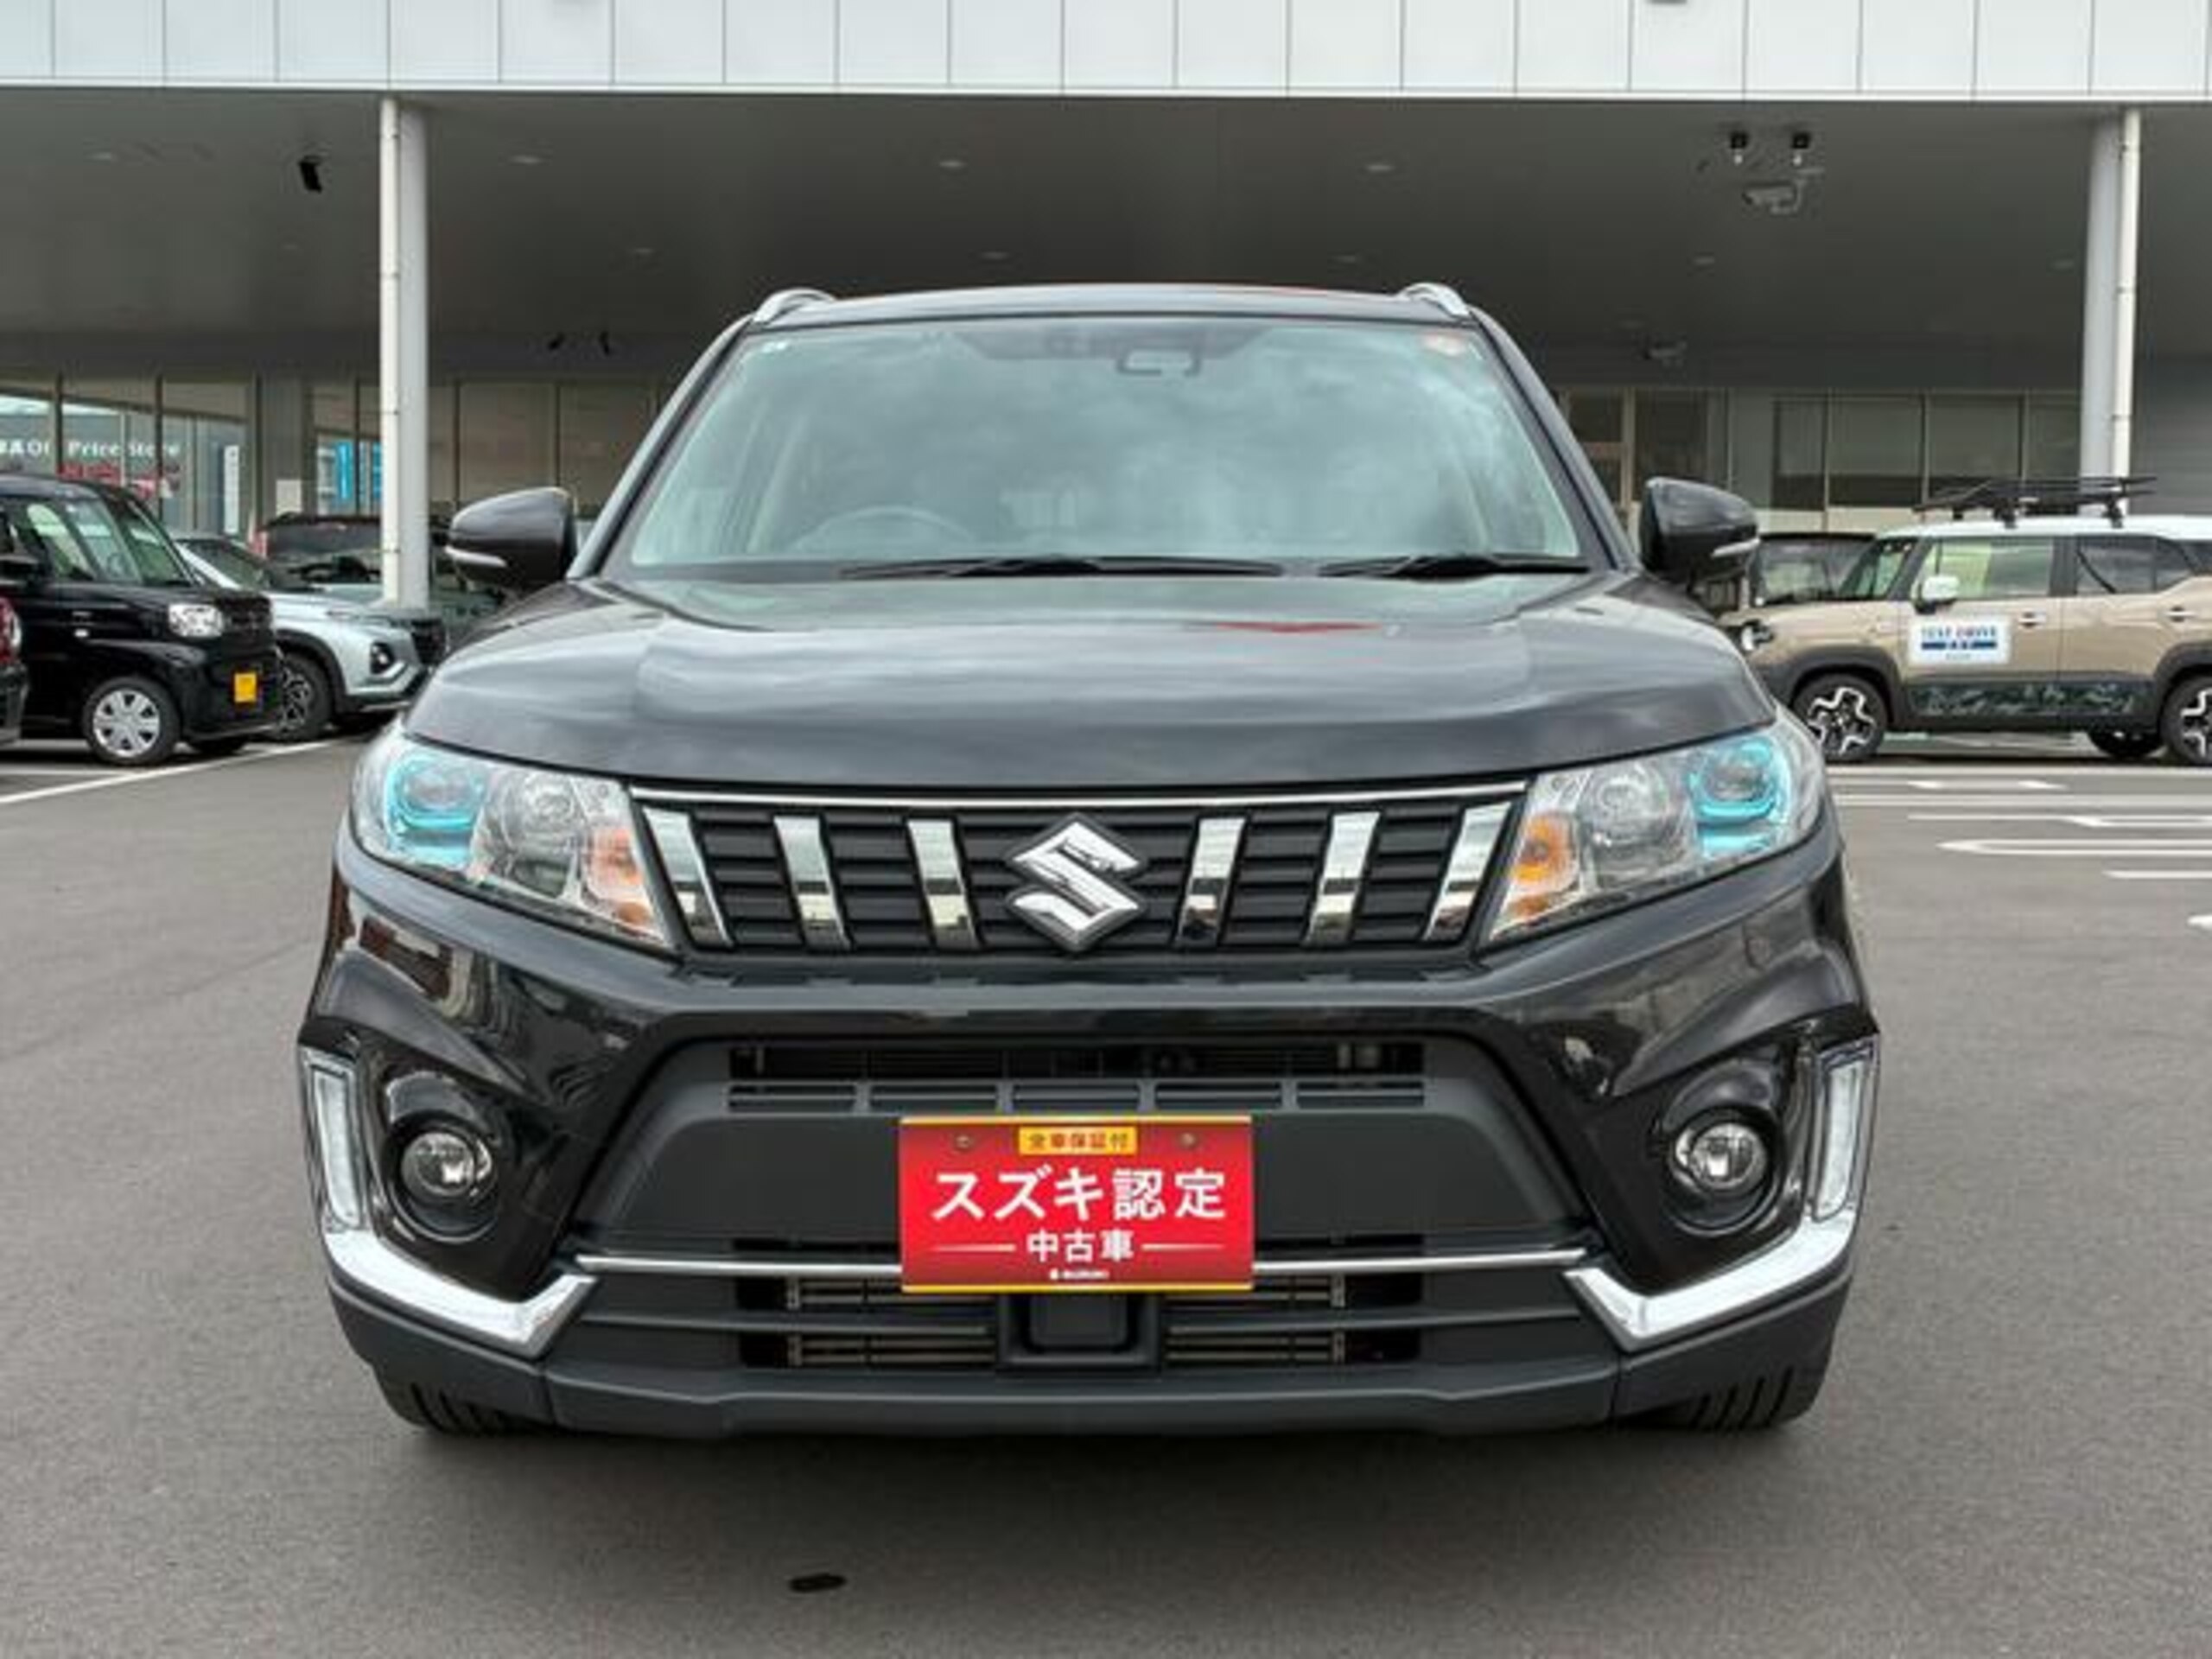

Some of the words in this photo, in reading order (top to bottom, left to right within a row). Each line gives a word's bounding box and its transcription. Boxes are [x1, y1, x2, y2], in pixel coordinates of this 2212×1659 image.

[931, 1164, 1227, 1222] スズキ認定
[1026, 1229, 1135, 1262] 中古車
